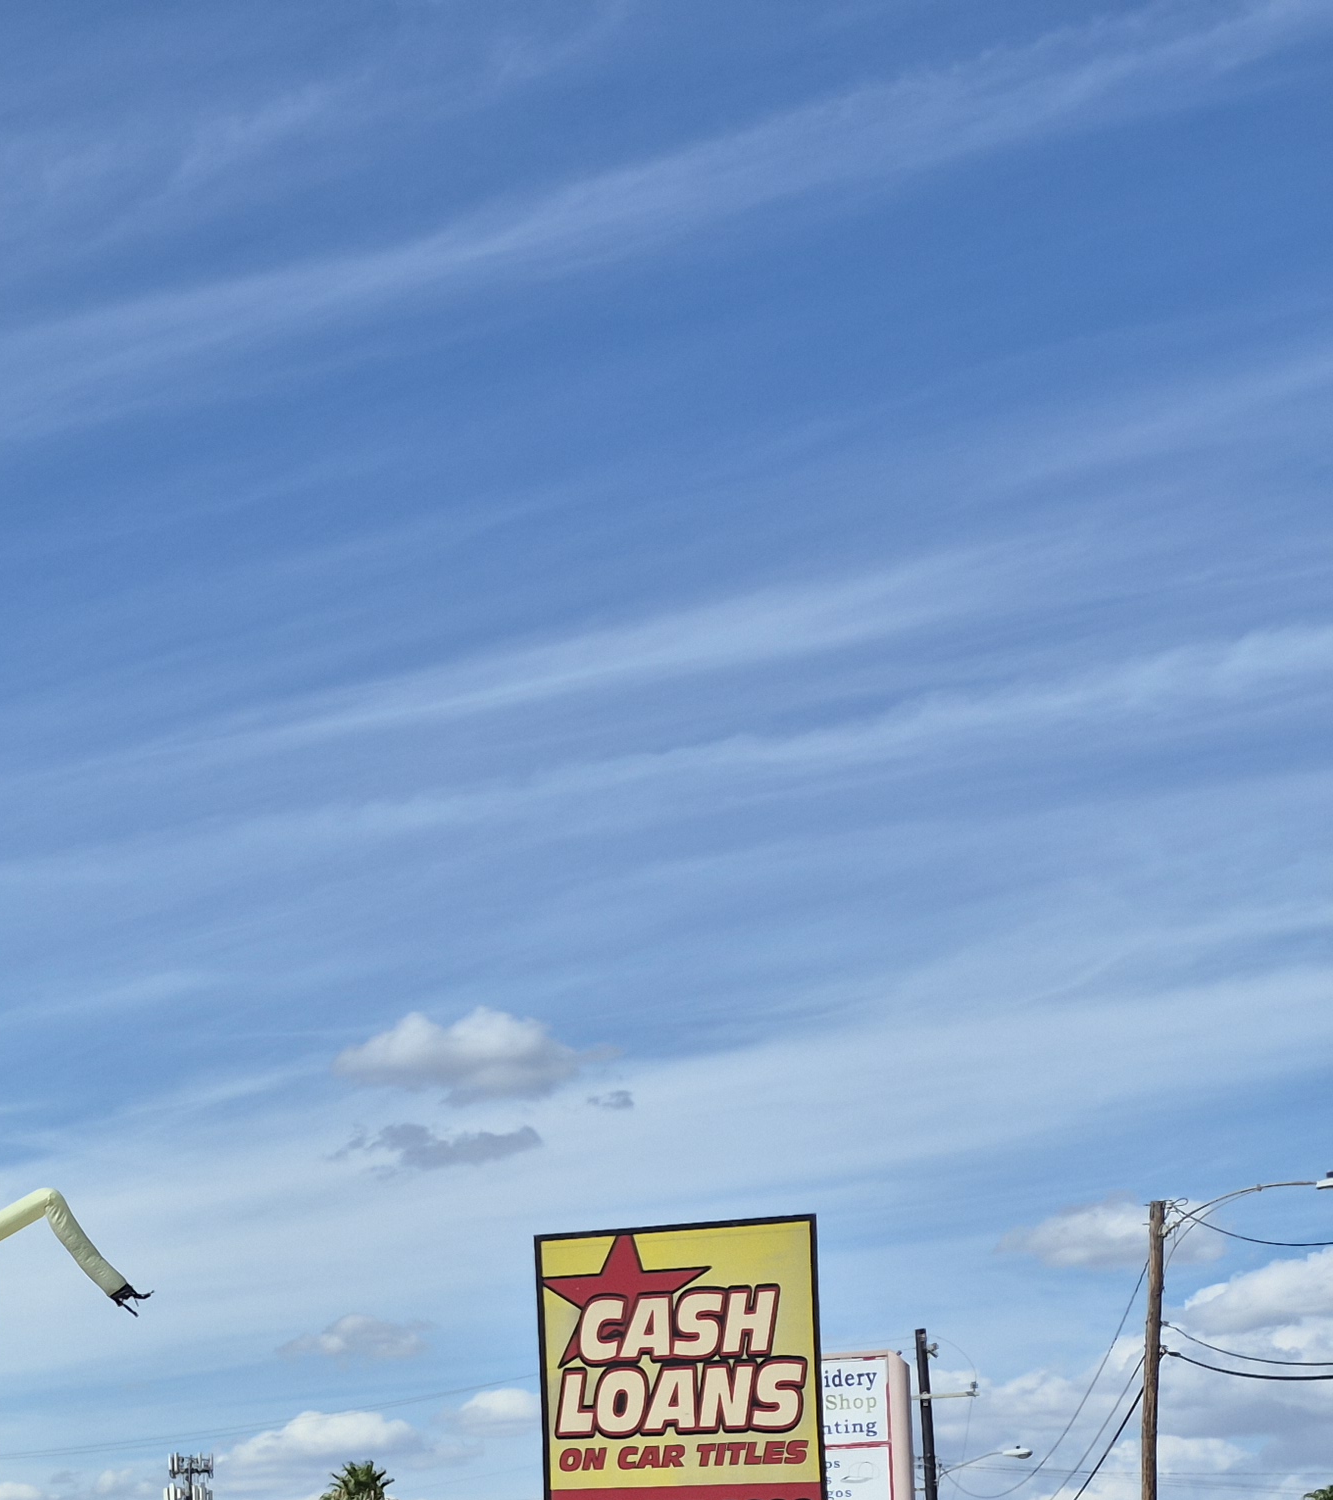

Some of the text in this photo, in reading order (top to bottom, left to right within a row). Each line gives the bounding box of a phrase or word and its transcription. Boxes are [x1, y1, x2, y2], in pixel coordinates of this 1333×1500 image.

[579, 1288, 777, 1362] CASH
[824, 1368, 877, 1391] idery
[558, 1361, 806, 1433] LOANS
[825, 1393, 877, 1413] Shop
[559, 1440, 809, 1471] ON CAR TITLES
